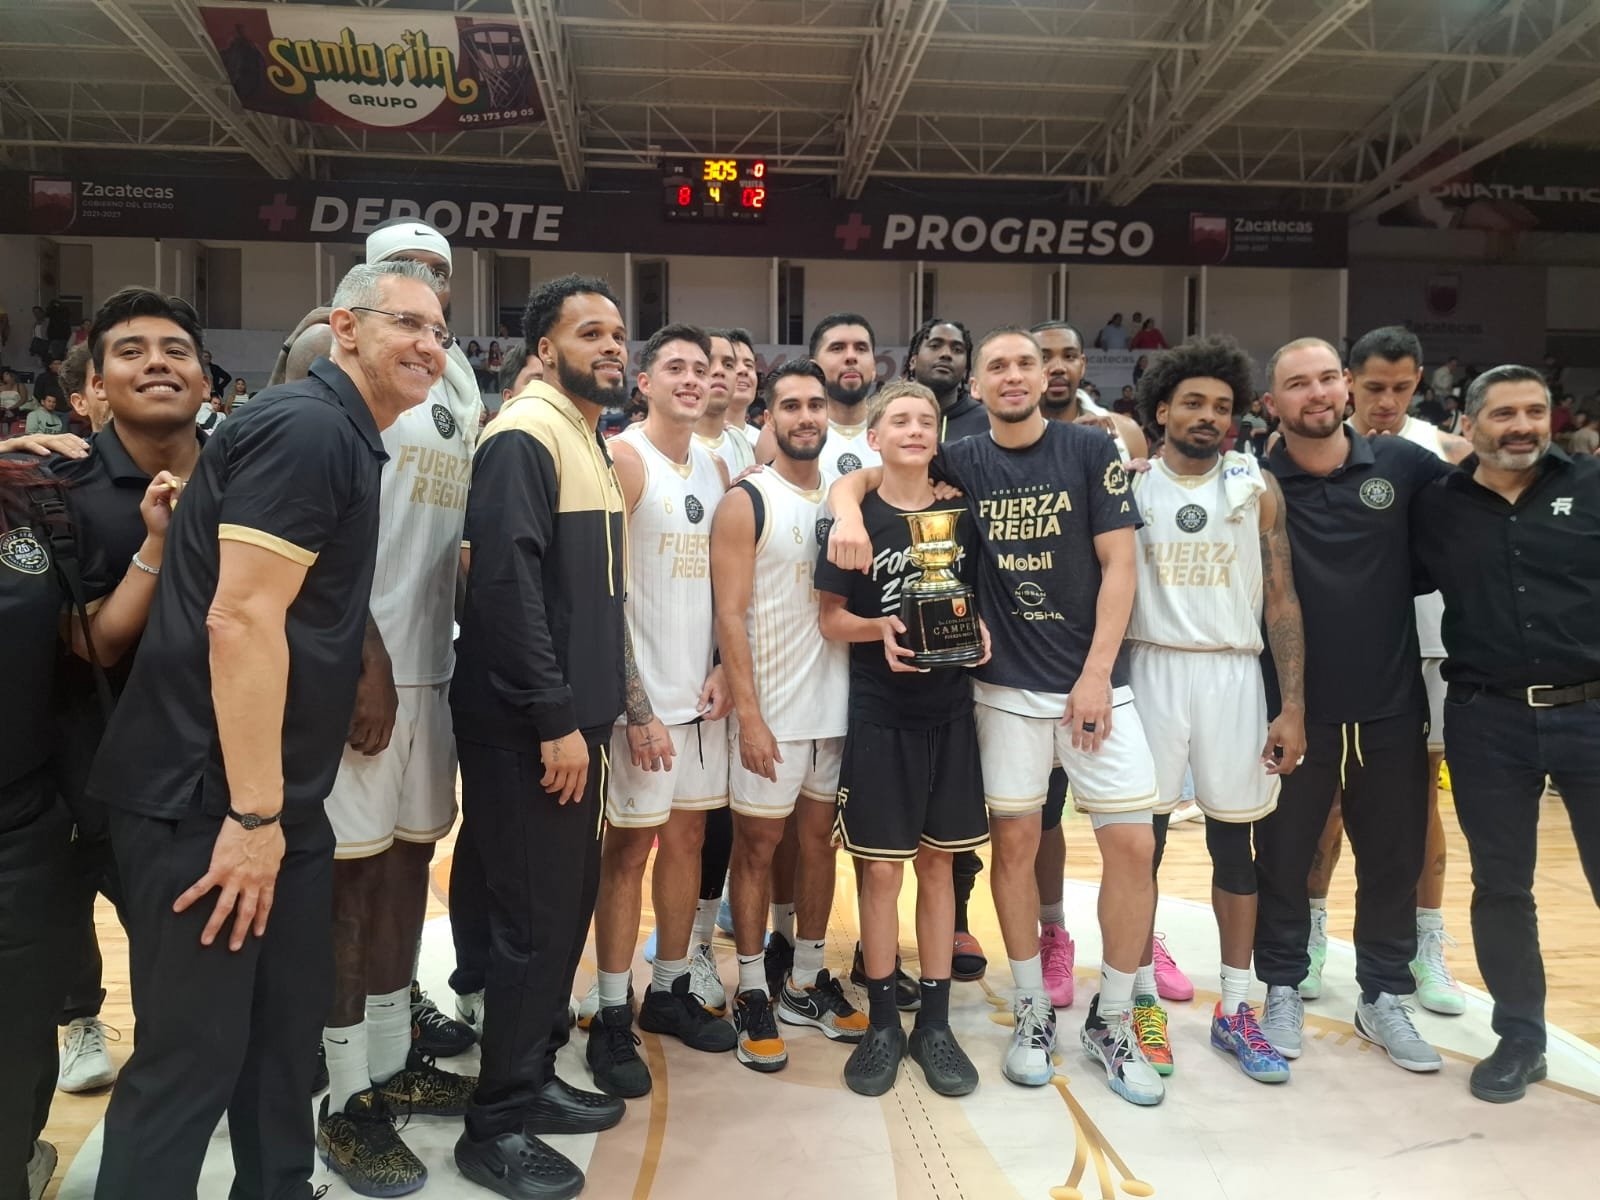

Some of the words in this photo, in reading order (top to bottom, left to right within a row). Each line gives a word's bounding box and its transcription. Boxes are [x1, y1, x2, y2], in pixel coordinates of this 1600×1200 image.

[349, 94, 417, 108] GRUPO
[458, 114, 480, 122] 492
[483, 112, 500, 121] 173
[503, 110, 517, 119] 09
[520, 108, 534, 116] 05
[82, 182, 174, 199] Zacatecas
[709, 187, 720, 203] 4
[126, 201, 141, 209] DEL
[143, 202, 174, 210] ESTADO
[309, 195, 564, 242] DEPORTE
[1234, 217, 1313, 233] Zacatecas
[882, 213, 1155, 258] PROGRESO
[1088, 355, 1135, 364] catecas
[397, 444, 471, 485] FUERZ
[663, 496, 673, 514] 6
[978, 490, 1073, 521] FUERZA
[1120, 500, 1131, 513] A
[792, 526, 804, 545] 8
[987, 514, 1062, 541] REGIA
[658, 532, 710, 556] FUER
[671, 556, 710, 579] REG
[997, 550, 1053, 571] Mobil
[1156, 564, 1232, 588] REGIA
